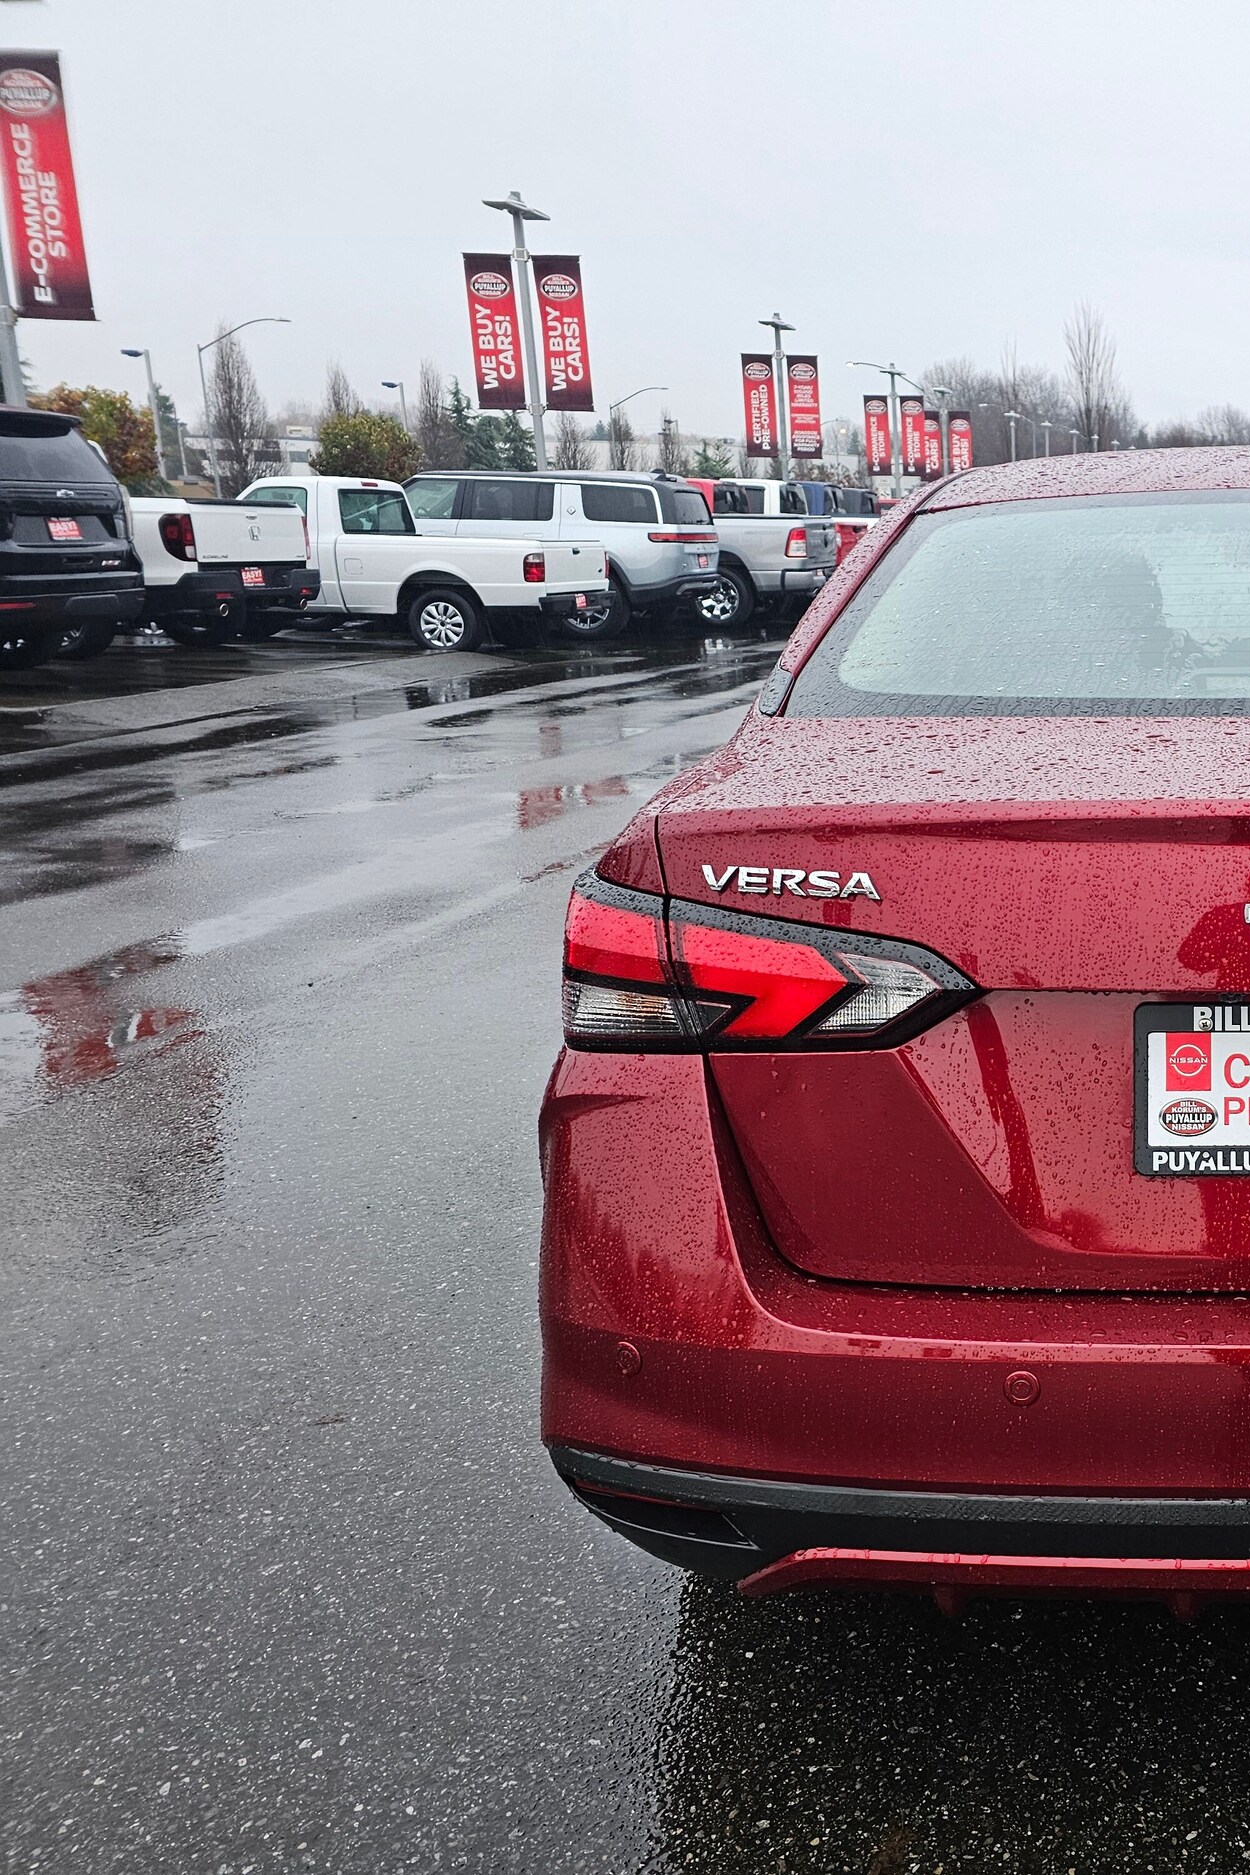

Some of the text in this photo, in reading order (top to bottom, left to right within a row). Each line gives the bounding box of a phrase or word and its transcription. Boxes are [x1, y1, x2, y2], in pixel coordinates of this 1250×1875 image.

[10, 122, 54, 303] E-COMMERCE
[37, 170, 67, 258] STORE
[474, 282, 506, 291] PUYALLUP
[544, 284, 574, 293] PUYALLUP
[475, 303, 499, 390] WE BUY
[494, 315, 516, 380] CARS!
[545, 305, 567, 391] WE BUY
[563, 317, 583, 382] CARS!
[751, 390, 762, 444] CERTIFIED
[759, 384, 771, 450] PRE-OWNED
[870, 416, 880, 472] E-COMMERCE
[877, 430, 886, 458] STORE
[906, 416, 915, 472] E-COMMERCE
[913, 430, 921, 458] STORE
[930, 439, 939, 470] CARS!
[952, 433, 961, 455] BUY
[960, 438, 970, 468] CARS!
[953, 457, 961, 473] WE
[241, 570, 262, 579] EASY!
[701, 864, 881, 900] VERSA
[1165, 1113, 1213, 1124] PUYALLUP
[1171, 1123, 1205, 1131] NISSAN
